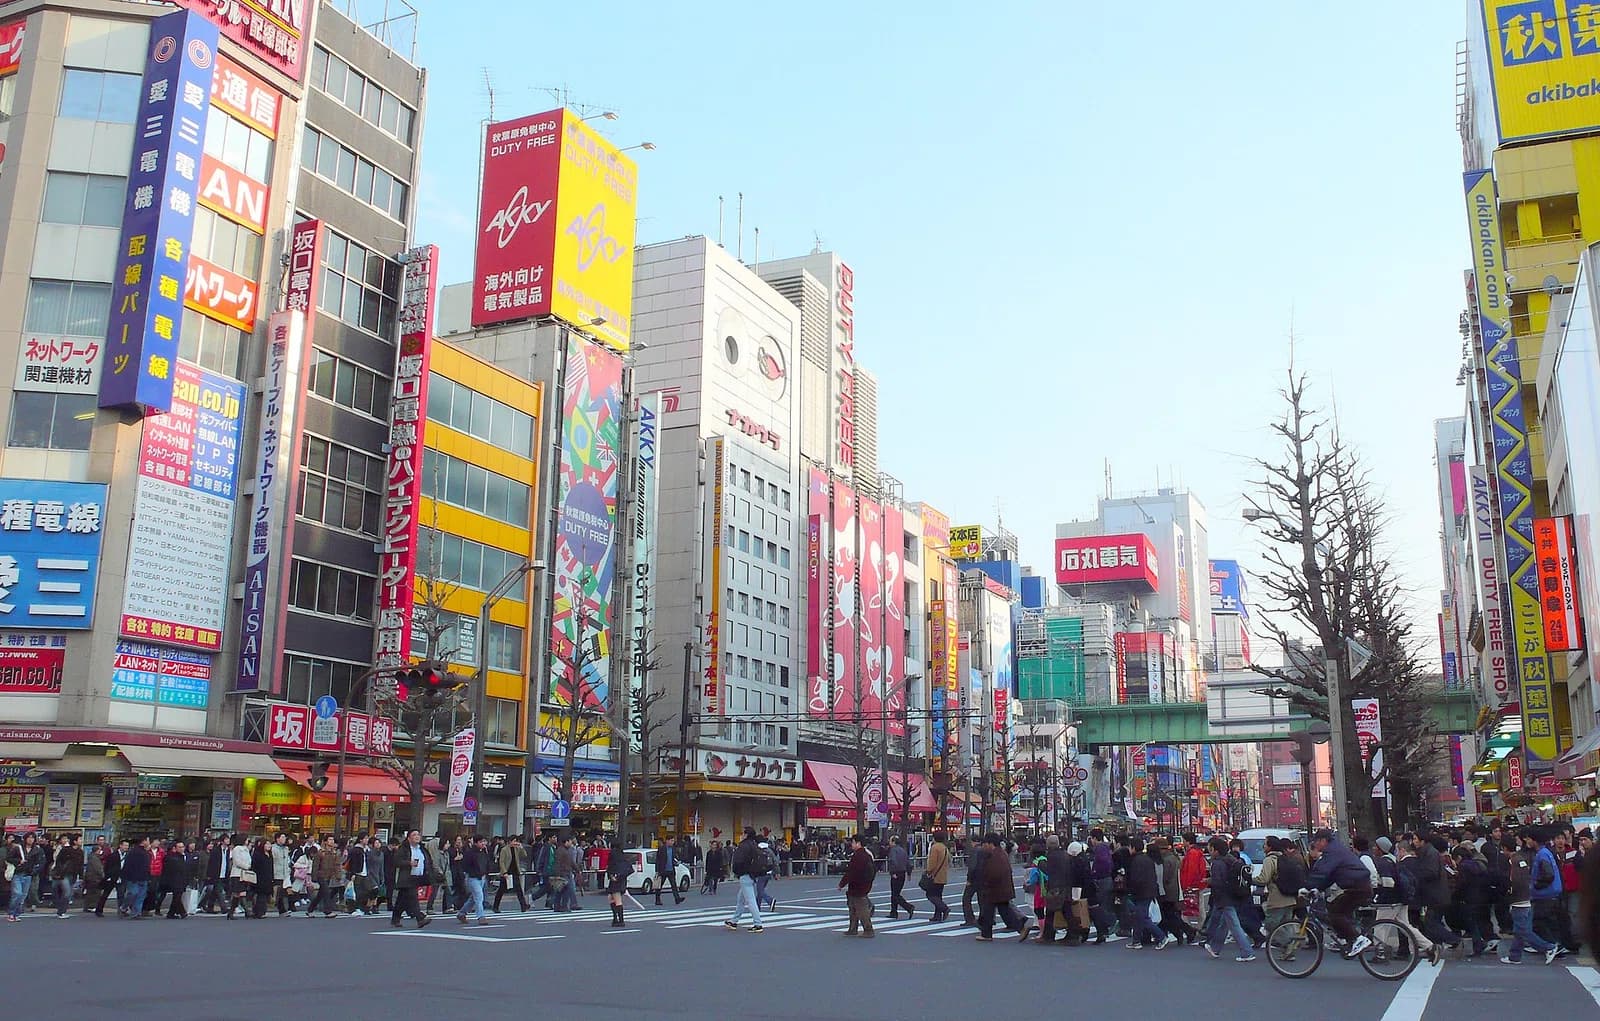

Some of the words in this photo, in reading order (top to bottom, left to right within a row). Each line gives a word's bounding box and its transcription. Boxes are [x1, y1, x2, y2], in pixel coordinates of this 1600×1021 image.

[491, 142, 522, 157] DUTY
[527, 135, 555, 149] FREE
[492, 121, 556, 143] 秋葉原免税中心
[485, 190, 552, 243] AKKY
[289, 229, 315, 310] 坂口電熱
[1476, 194, 1499, 309] akibakan.com
[484, 286, 542, 311] 電気製品
[485, 265, 543, 292] 海外向け
[840, 263, 853, 363] DUTY
[24, 365, 93, 385] 関連機材
[25, 338, 99, 365] ネットワーク
[640, 406, 655, 469] AKKY
[725, 409, 781, 451] ナカウラ
[840, 369, 853, 467] FREE
[1, 499, 100, 533] 種電線
[636, 459, 646, 540] INTERNATIONAL
[1473, 475, 1492, 533] AKKY
[565, 520, 586, 538] DUTY
[589, 528, 608, 545] FREE
[1060, 545, 1139, 571] 石丸電気
[1482, 557, 1499, 604] DUTY
[636, 563, 649, 615] DUTY
[1561, 557, 1573, 610] YOSHINOYA
[242, 570, 262, 677] AISAN
[1487, 609, 1502, 650] FREE
[1522, 604, 1550, 736] ここが秋葉館
[735, 756, 797, 781] ナカウラ
